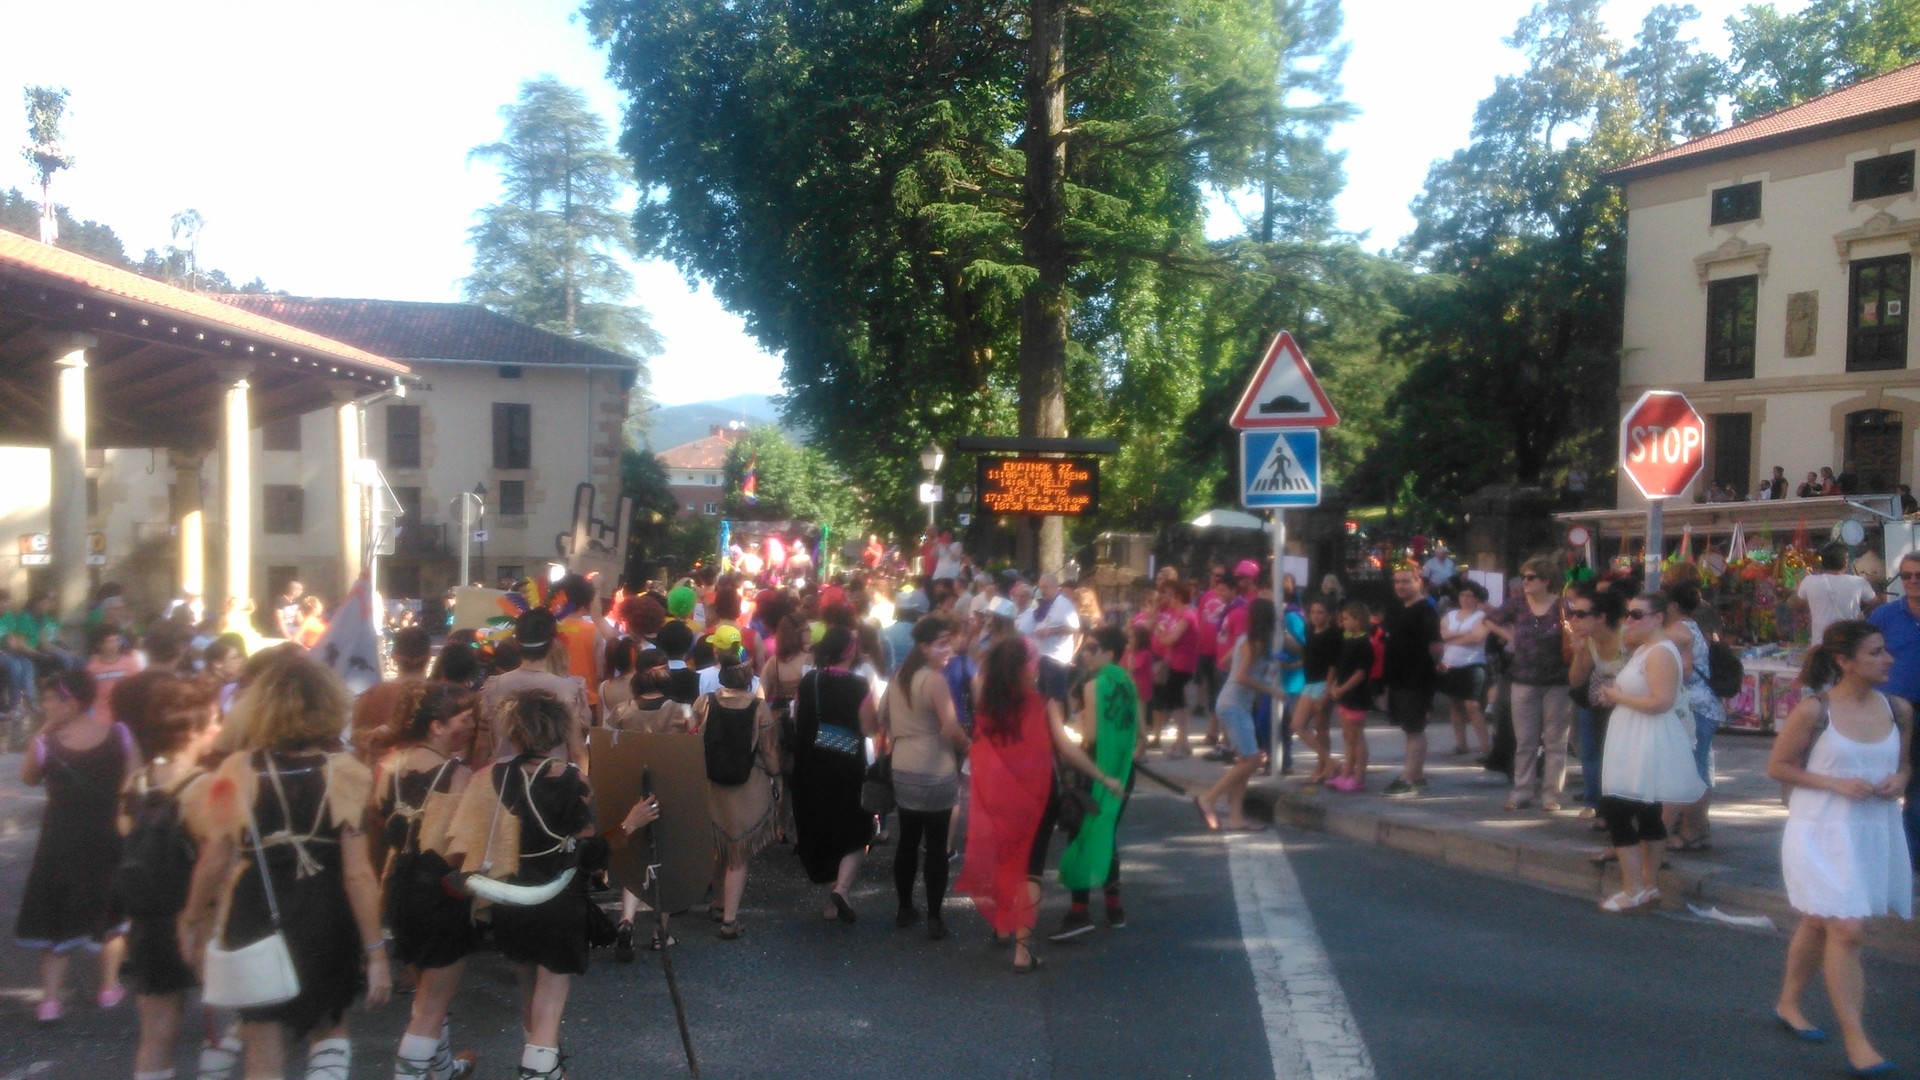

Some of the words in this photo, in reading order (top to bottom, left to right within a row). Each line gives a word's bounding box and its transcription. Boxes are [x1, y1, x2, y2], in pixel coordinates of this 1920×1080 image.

[1629, 425, 1700, 464] STOP
[1003, 462, 1052, 471] EKAINAK
[1058, 463, 1073, 472] 27
[1000, 479, 1029, 487] 14:00
[1034, 479, 1070, 488] PAELLA
[985, 493, 1014, 503] 17:30
